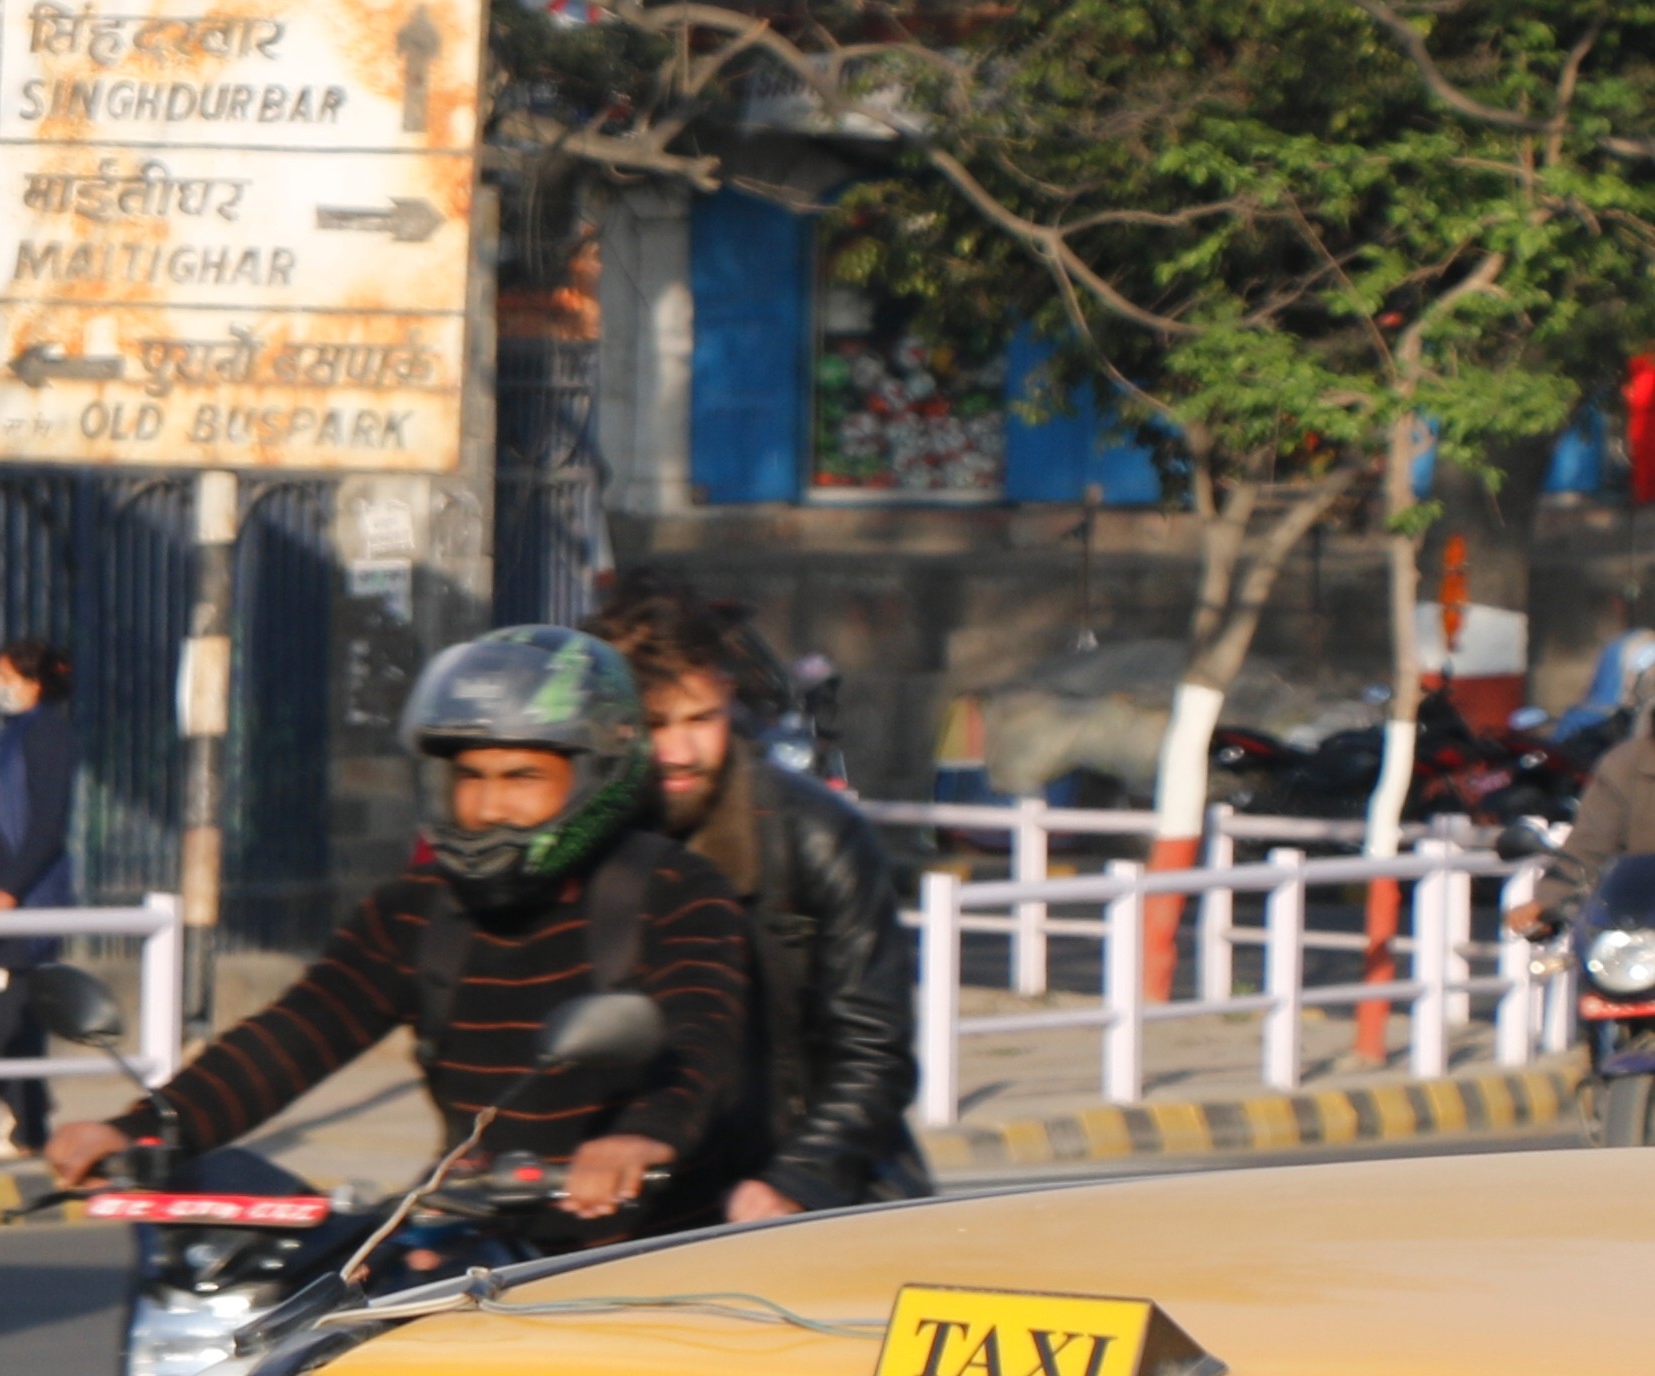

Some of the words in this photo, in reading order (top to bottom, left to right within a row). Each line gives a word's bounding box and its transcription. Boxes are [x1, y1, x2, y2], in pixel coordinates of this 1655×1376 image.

[19, 79, 347, 124] SINGHDURBAR
[14, 238, 297, 286] MAITIGHAR
[80, 401, 165, 441] OLD
